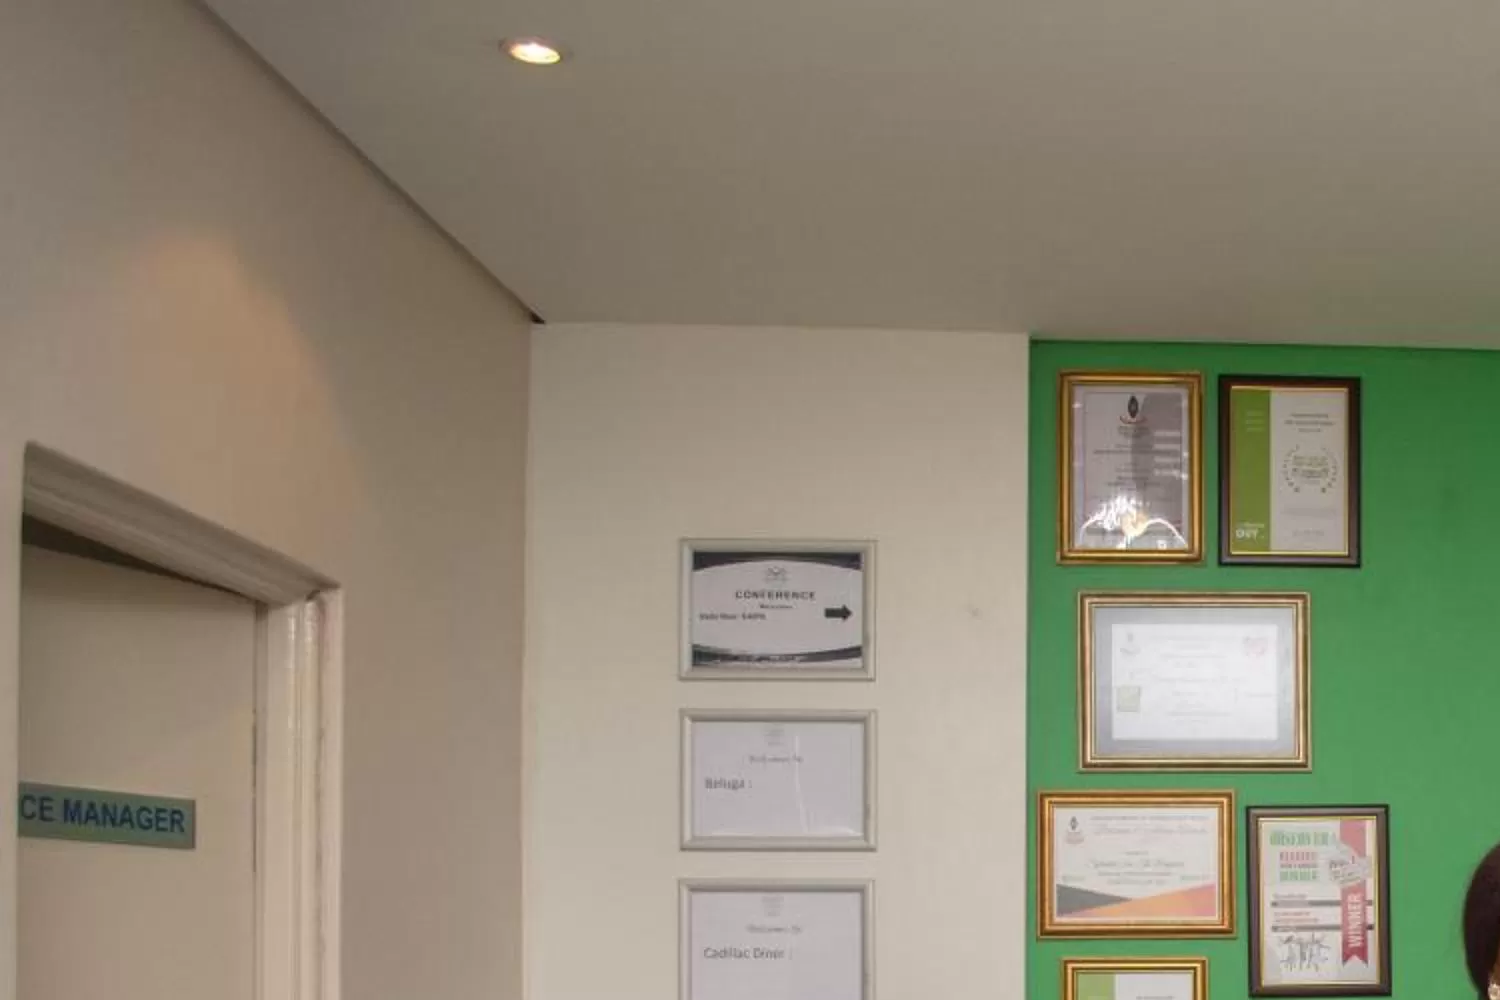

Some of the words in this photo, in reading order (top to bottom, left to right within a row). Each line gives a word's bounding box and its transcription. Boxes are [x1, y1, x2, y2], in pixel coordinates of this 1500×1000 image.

[735, 590, 816, 600] CONFERENCE
[63, 798, 185, 833] MANAGER
[703, 946, 749, 959] Cadillac
